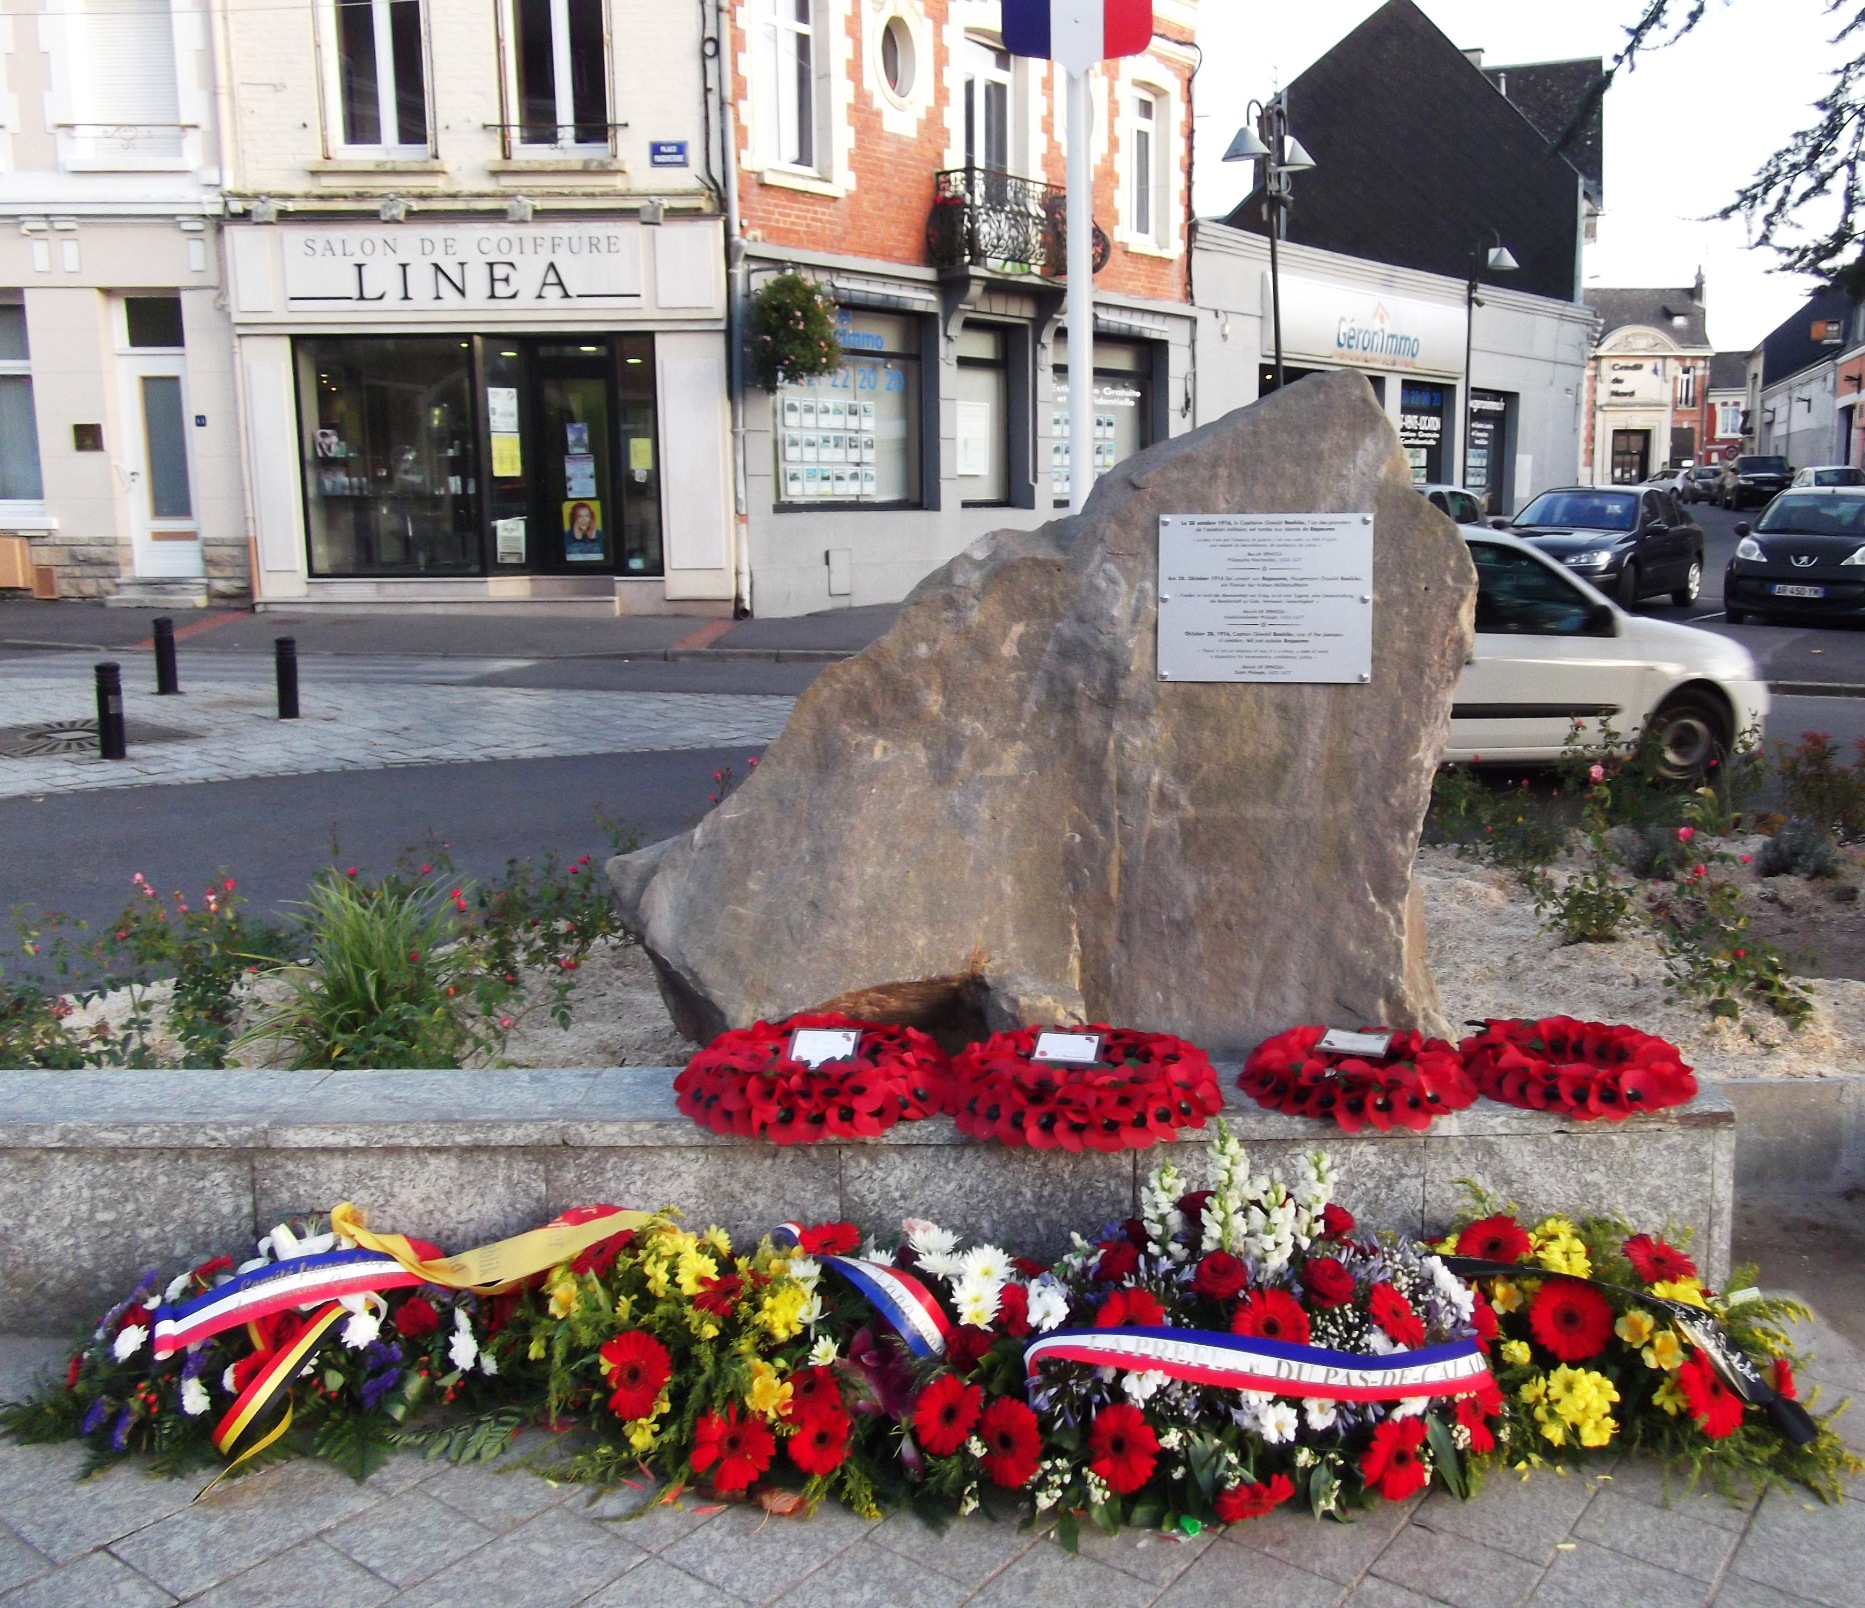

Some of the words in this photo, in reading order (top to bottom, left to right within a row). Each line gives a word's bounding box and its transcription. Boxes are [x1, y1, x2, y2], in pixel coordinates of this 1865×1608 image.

[303, 237, 398, 257] SALON
[420, 237, 458, 256] DE
[477, 234, 621, 256] COIFFURE
[353, 260, 573, 301] LINEA
[1085, 1335, 1126, 1355] LA
[1275, 1359, 1313, 1382] DU
